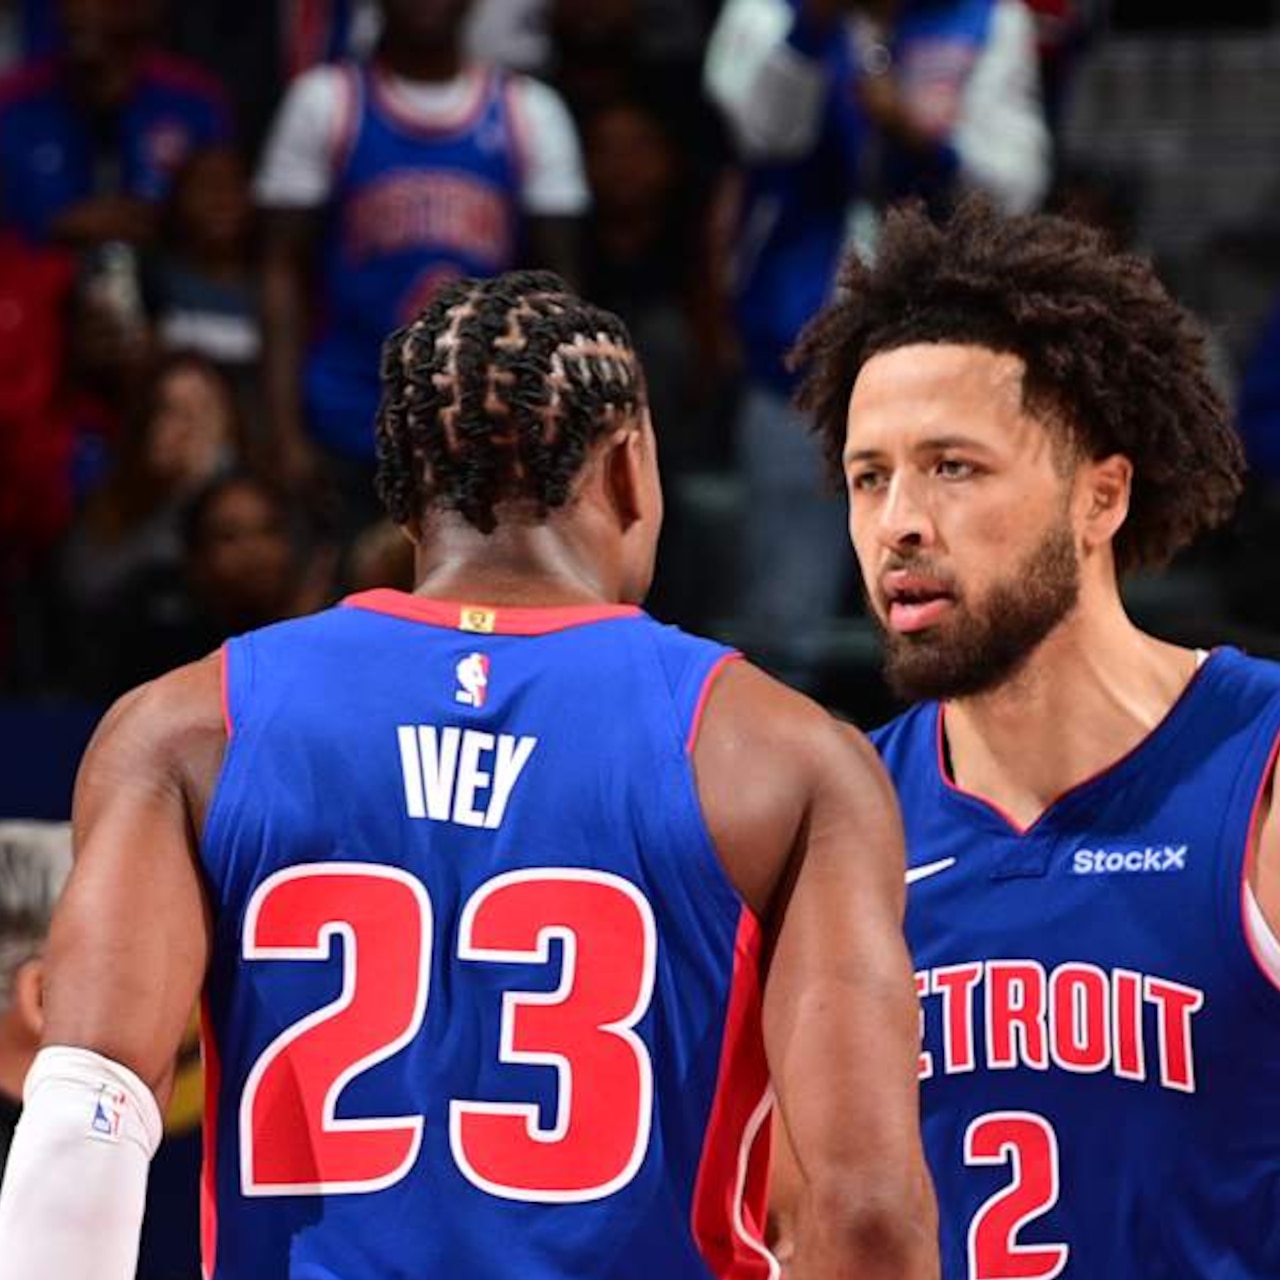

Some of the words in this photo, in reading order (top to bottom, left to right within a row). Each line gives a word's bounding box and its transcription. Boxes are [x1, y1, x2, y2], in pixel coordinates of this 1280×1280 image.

[396, 725, 537, 830] IVEY
[1071, 845, 1189, 874] StockX
[240, 861, 658, 1204] 23
